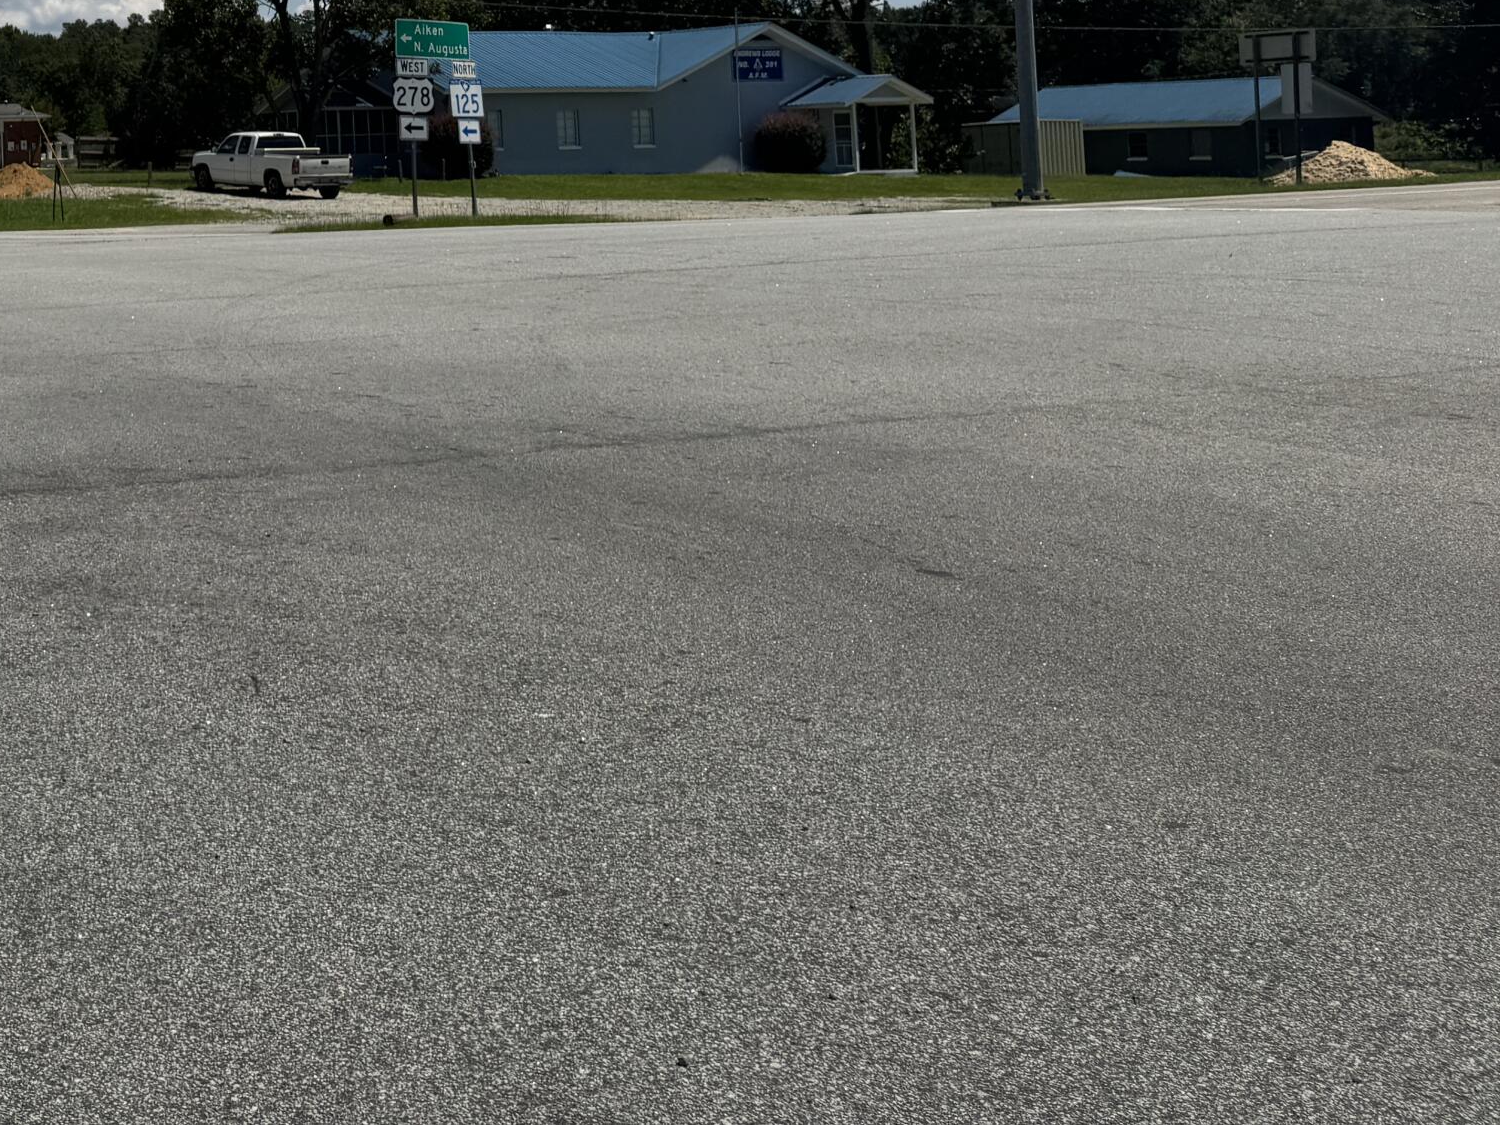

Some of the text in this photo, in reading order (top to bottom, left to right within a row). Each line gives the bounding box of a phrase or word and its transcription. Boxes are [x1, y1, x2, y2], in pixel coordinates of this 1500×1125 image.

[414, 24, 444, 36] Aiken
[413, 42, 468, 56] N. Augusta
[400, 60, 425, 73] WEST
[453, 63, 476, 75] NORTH
[396, 86, 431, 107] 278
[455, 94, 479, 114] 125
